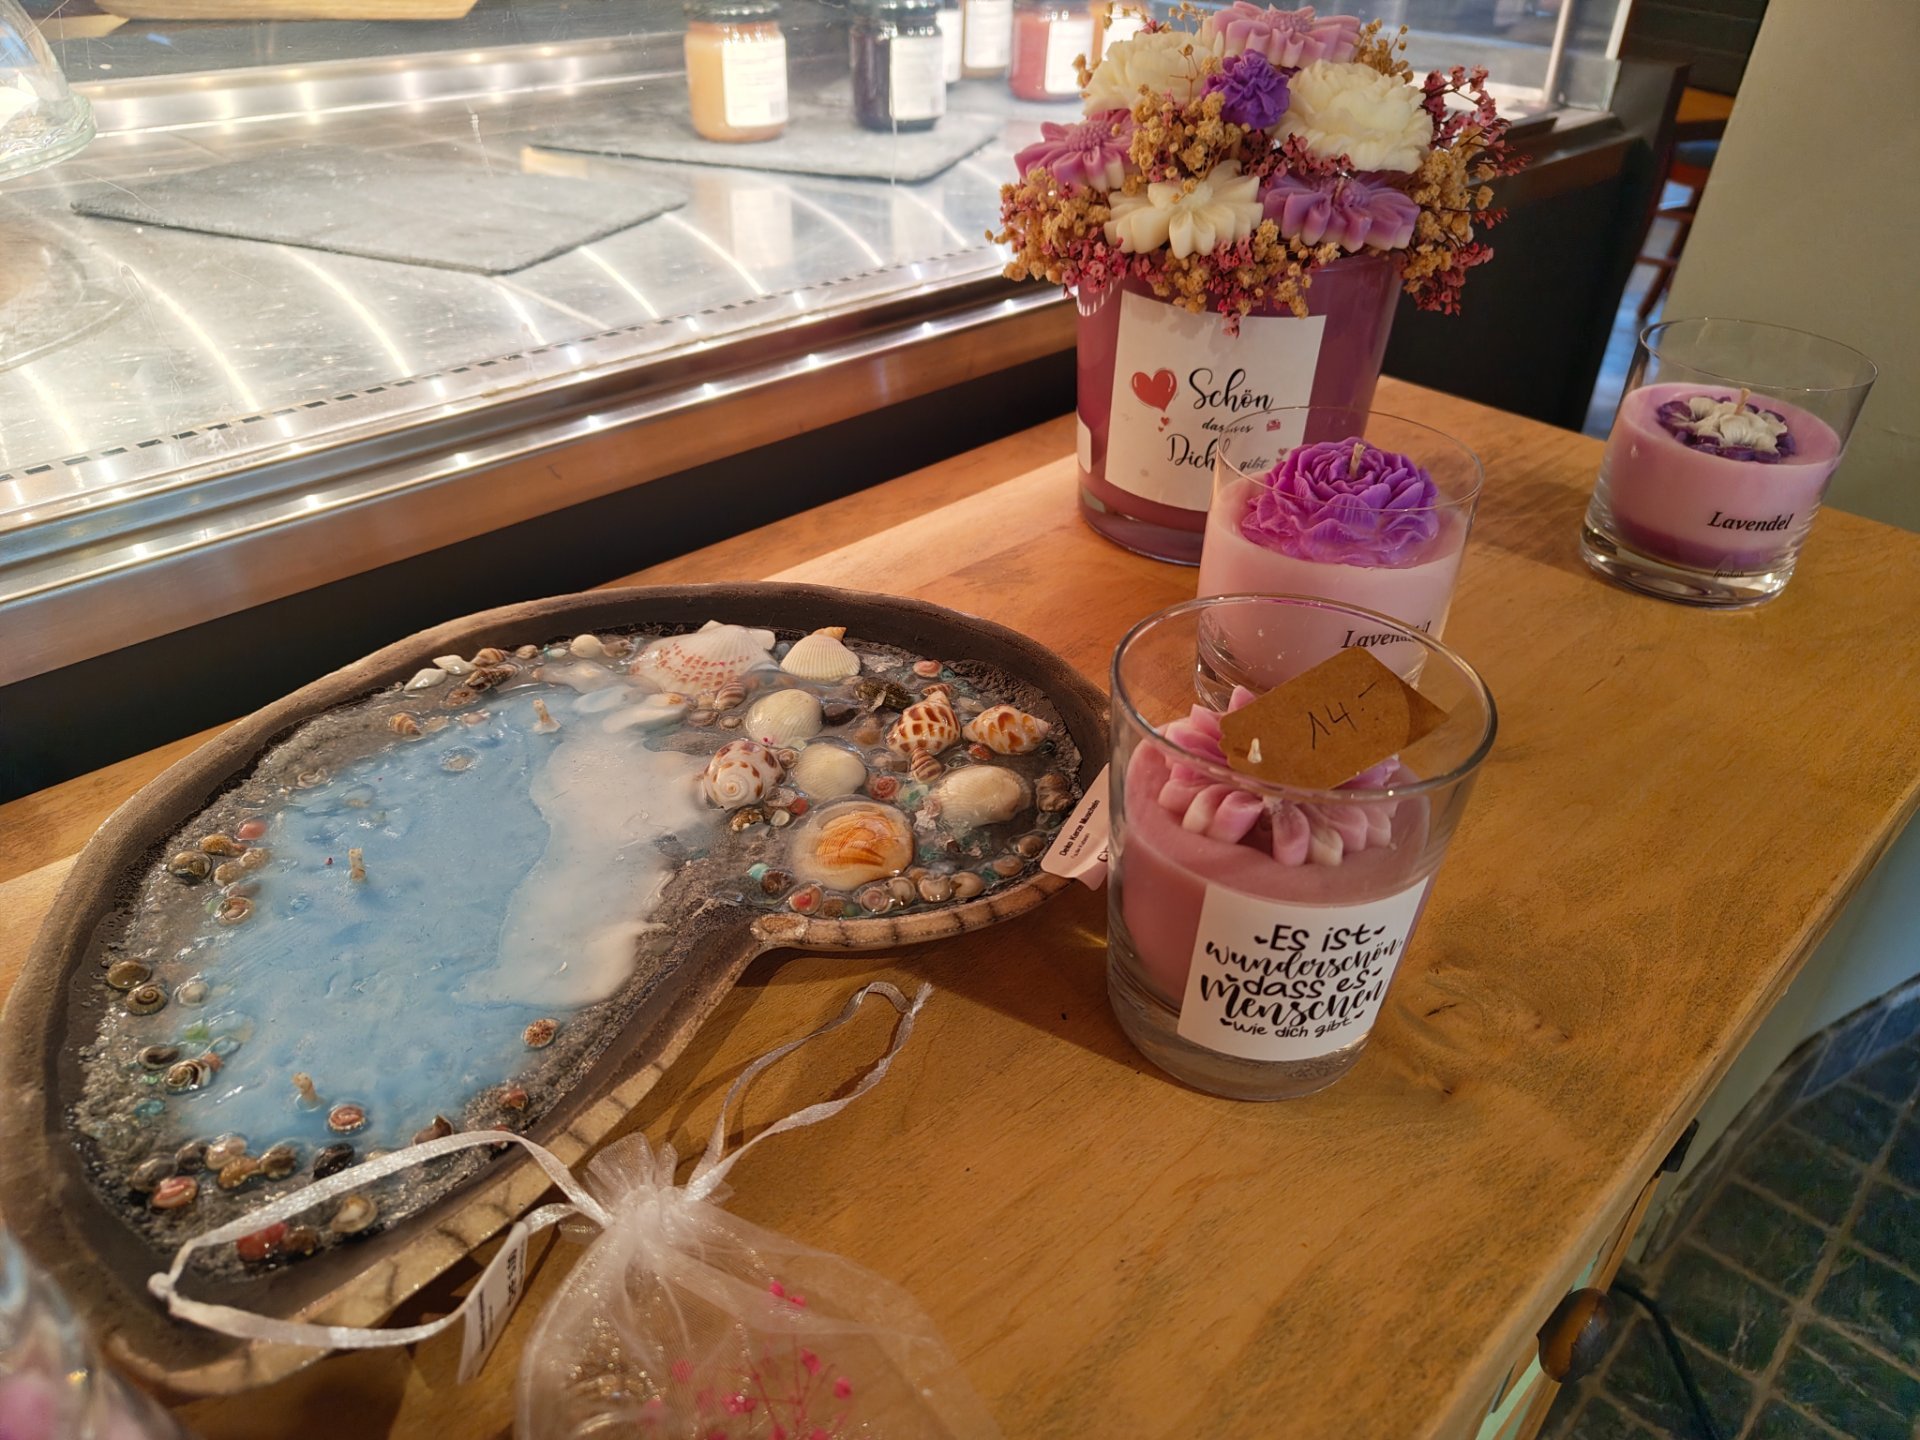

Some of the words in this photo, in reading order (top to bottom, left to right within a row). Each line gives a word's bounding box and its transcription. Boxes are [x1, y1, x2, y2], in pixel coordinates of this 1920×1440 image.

[1189, 368, 1273, 412] Schön
[1167, 434, 1218, 472] Dich
[1707, 511, 1794, 531] Lavendel
[1060, 841, 1073, 856] Deko
[1069, 824, 1083, 841] Kerze
[1243, 975, 1325, 999] dass
[1336, 969, 1368, 993] es
[1201, 975, 1388, 1027] Menschen
[1275, 1025, 1309, 1038] dich
[1314, 1016, 1352, 1038] gibt
